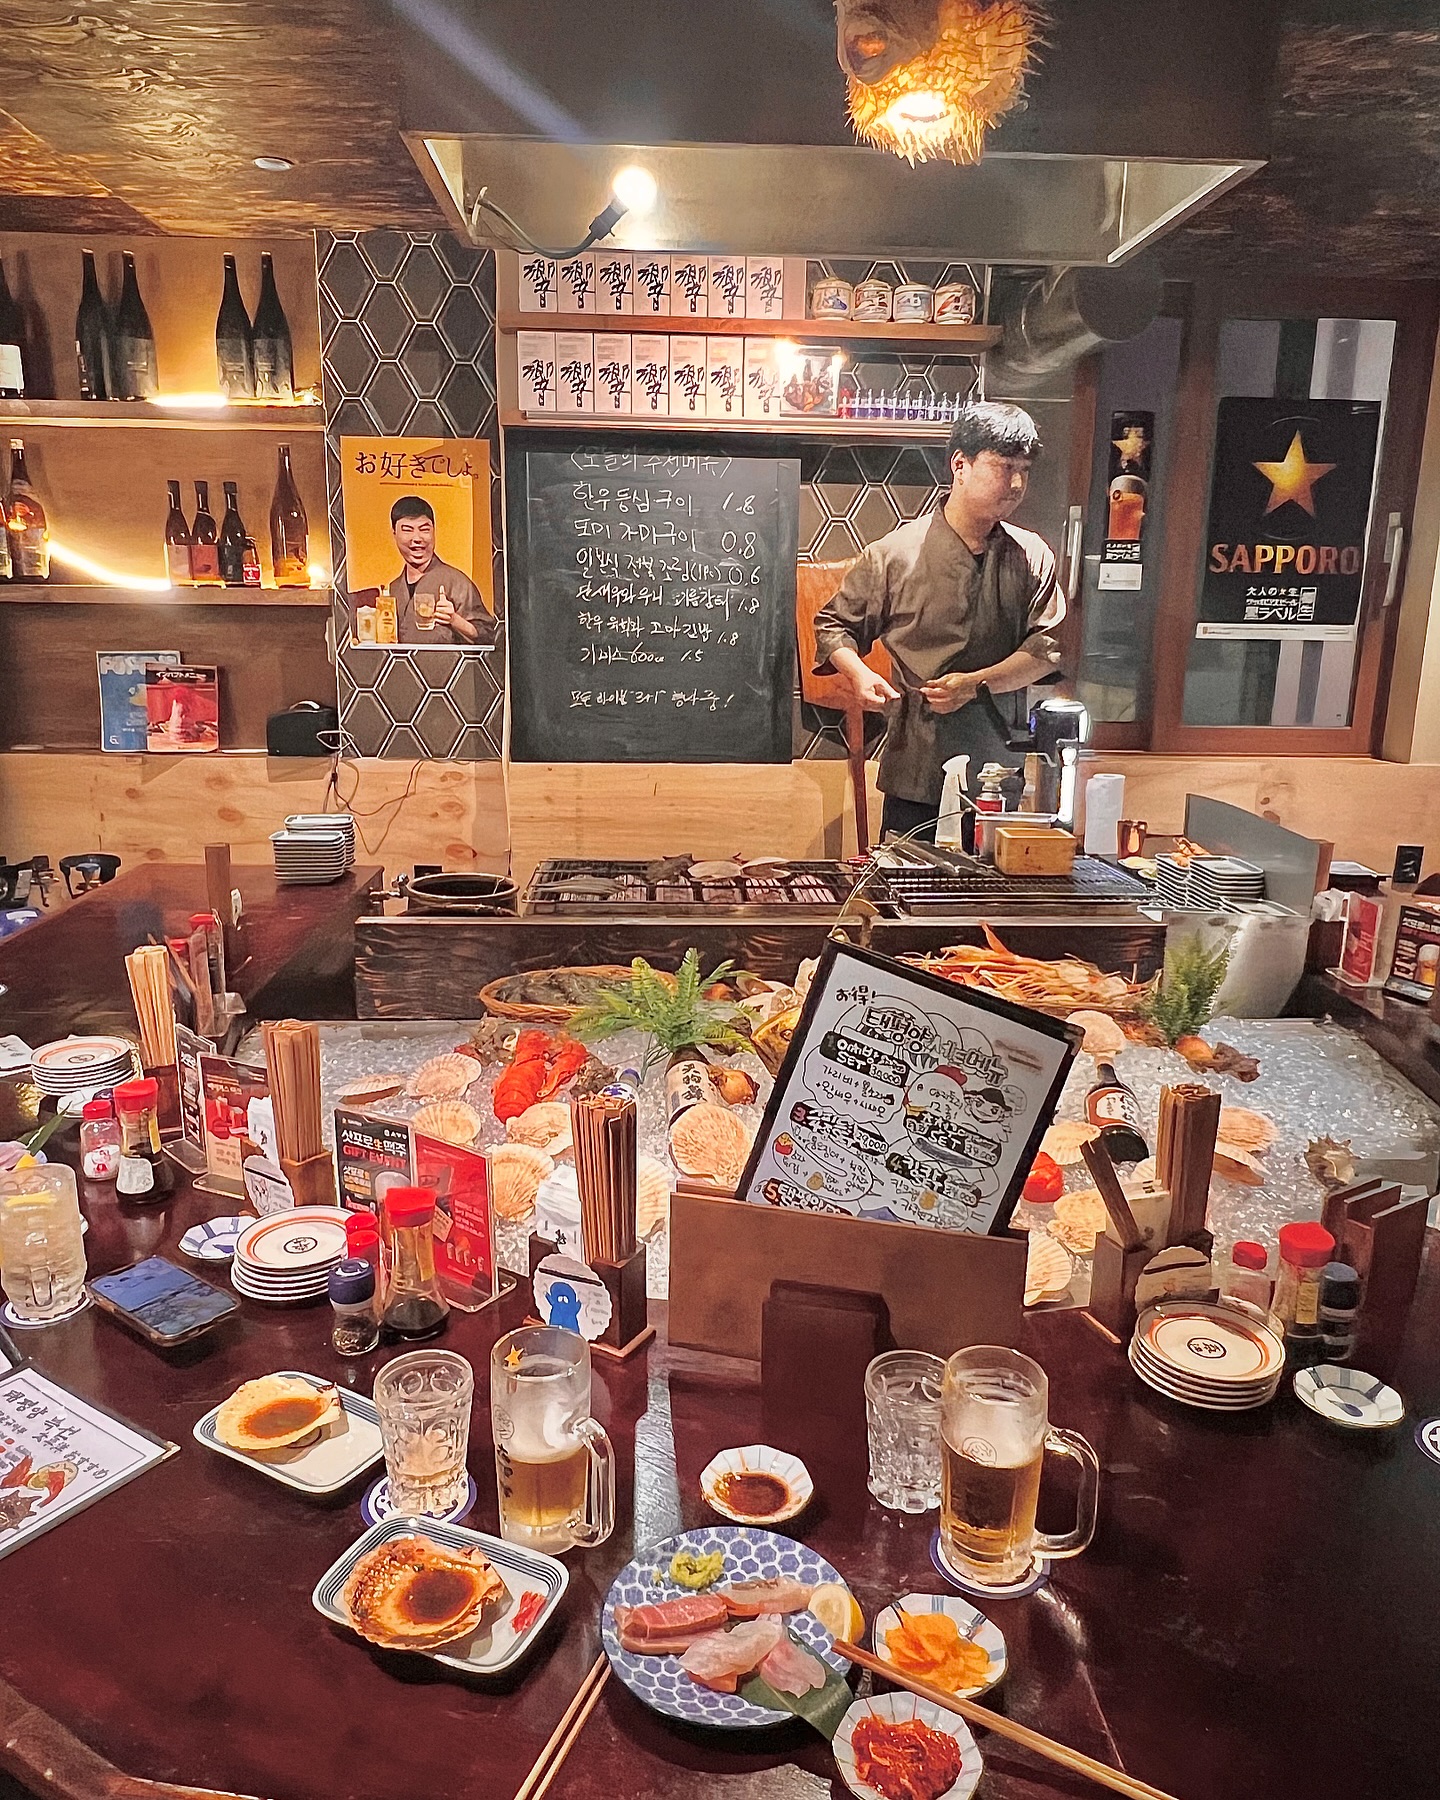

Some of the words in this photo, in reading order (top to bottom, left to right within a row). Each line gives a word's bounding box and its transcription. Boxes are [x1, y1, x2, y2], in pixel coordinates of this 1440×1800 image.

[722, 492, 756, 515] 1.8
[721, 530, 757, 560] 0.8
[1208, 543, 1360, 575] SAPPORO
[728, 565, 761, 586] 0.6
[737, 597, 760, 614] 1.8
[717, 631, 740, 646] 1.8
[680, 649, 704, 662] 1.5
[836, 1051, 867, 1070] SET
[929, 1130, 962, 1150] SET
